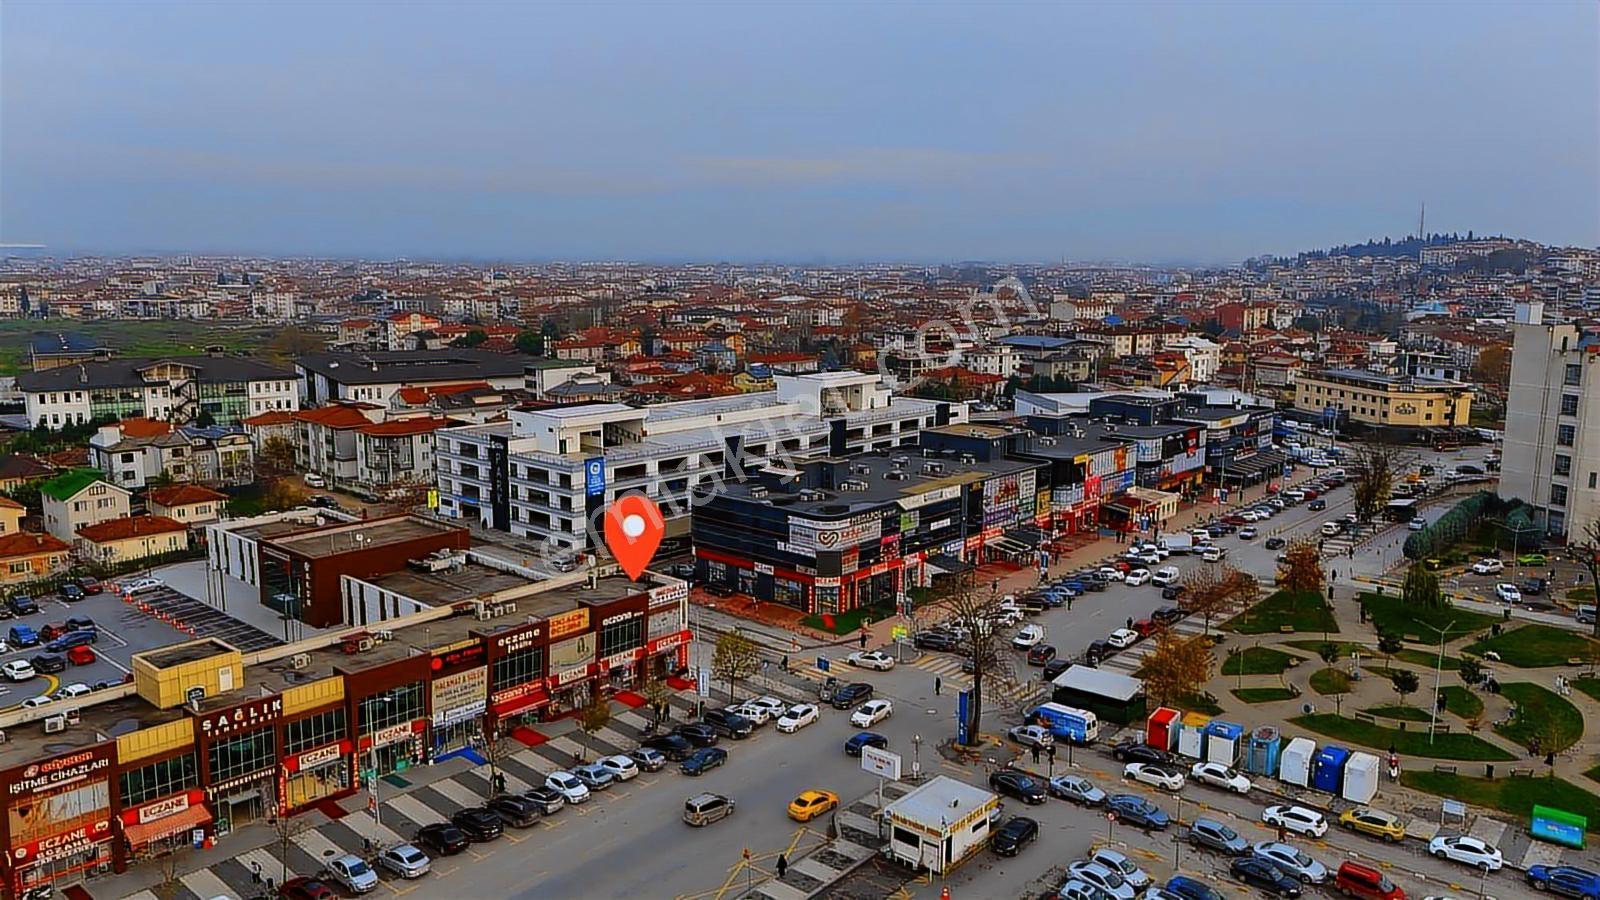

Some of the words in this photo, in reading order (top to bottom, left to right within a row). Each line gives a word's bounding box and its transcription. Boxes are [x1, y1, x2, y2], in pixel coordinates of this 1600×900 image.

[498, 628, 540, 647] eczane
[202, 700, 281, 731] SAĞLIK
[301, 747, 338, 765] ECZANE
[143, 798, 185, 818] ECZANE
[38, 828, 86, 851] ECZANE
